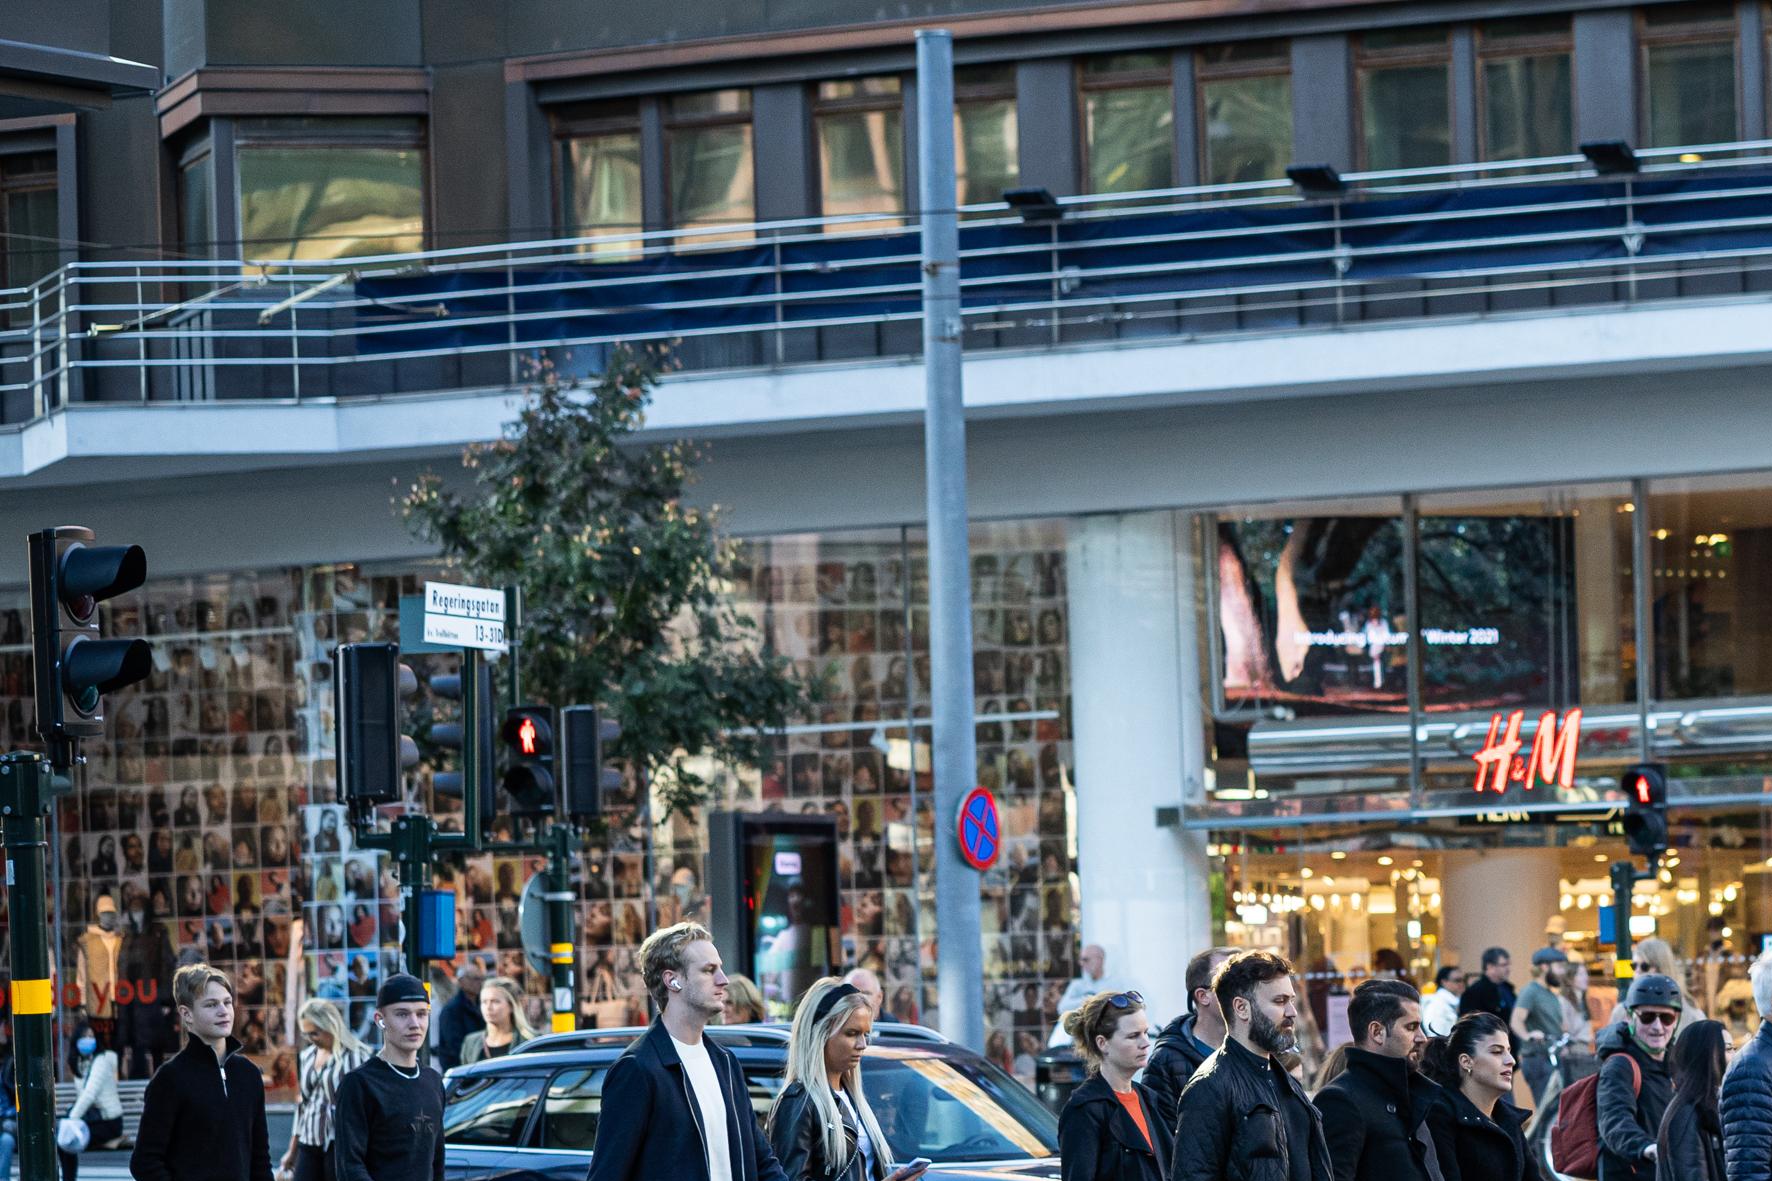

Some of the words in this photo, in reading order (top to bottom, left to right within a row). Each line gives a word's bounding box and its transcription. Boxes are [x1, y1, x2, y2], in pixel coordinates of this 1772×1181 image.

[432, 589, 500, 618] Regeringsgatan
[1472, 707, 1583, 795] H&M
[92, 978, 158, 1015] you
